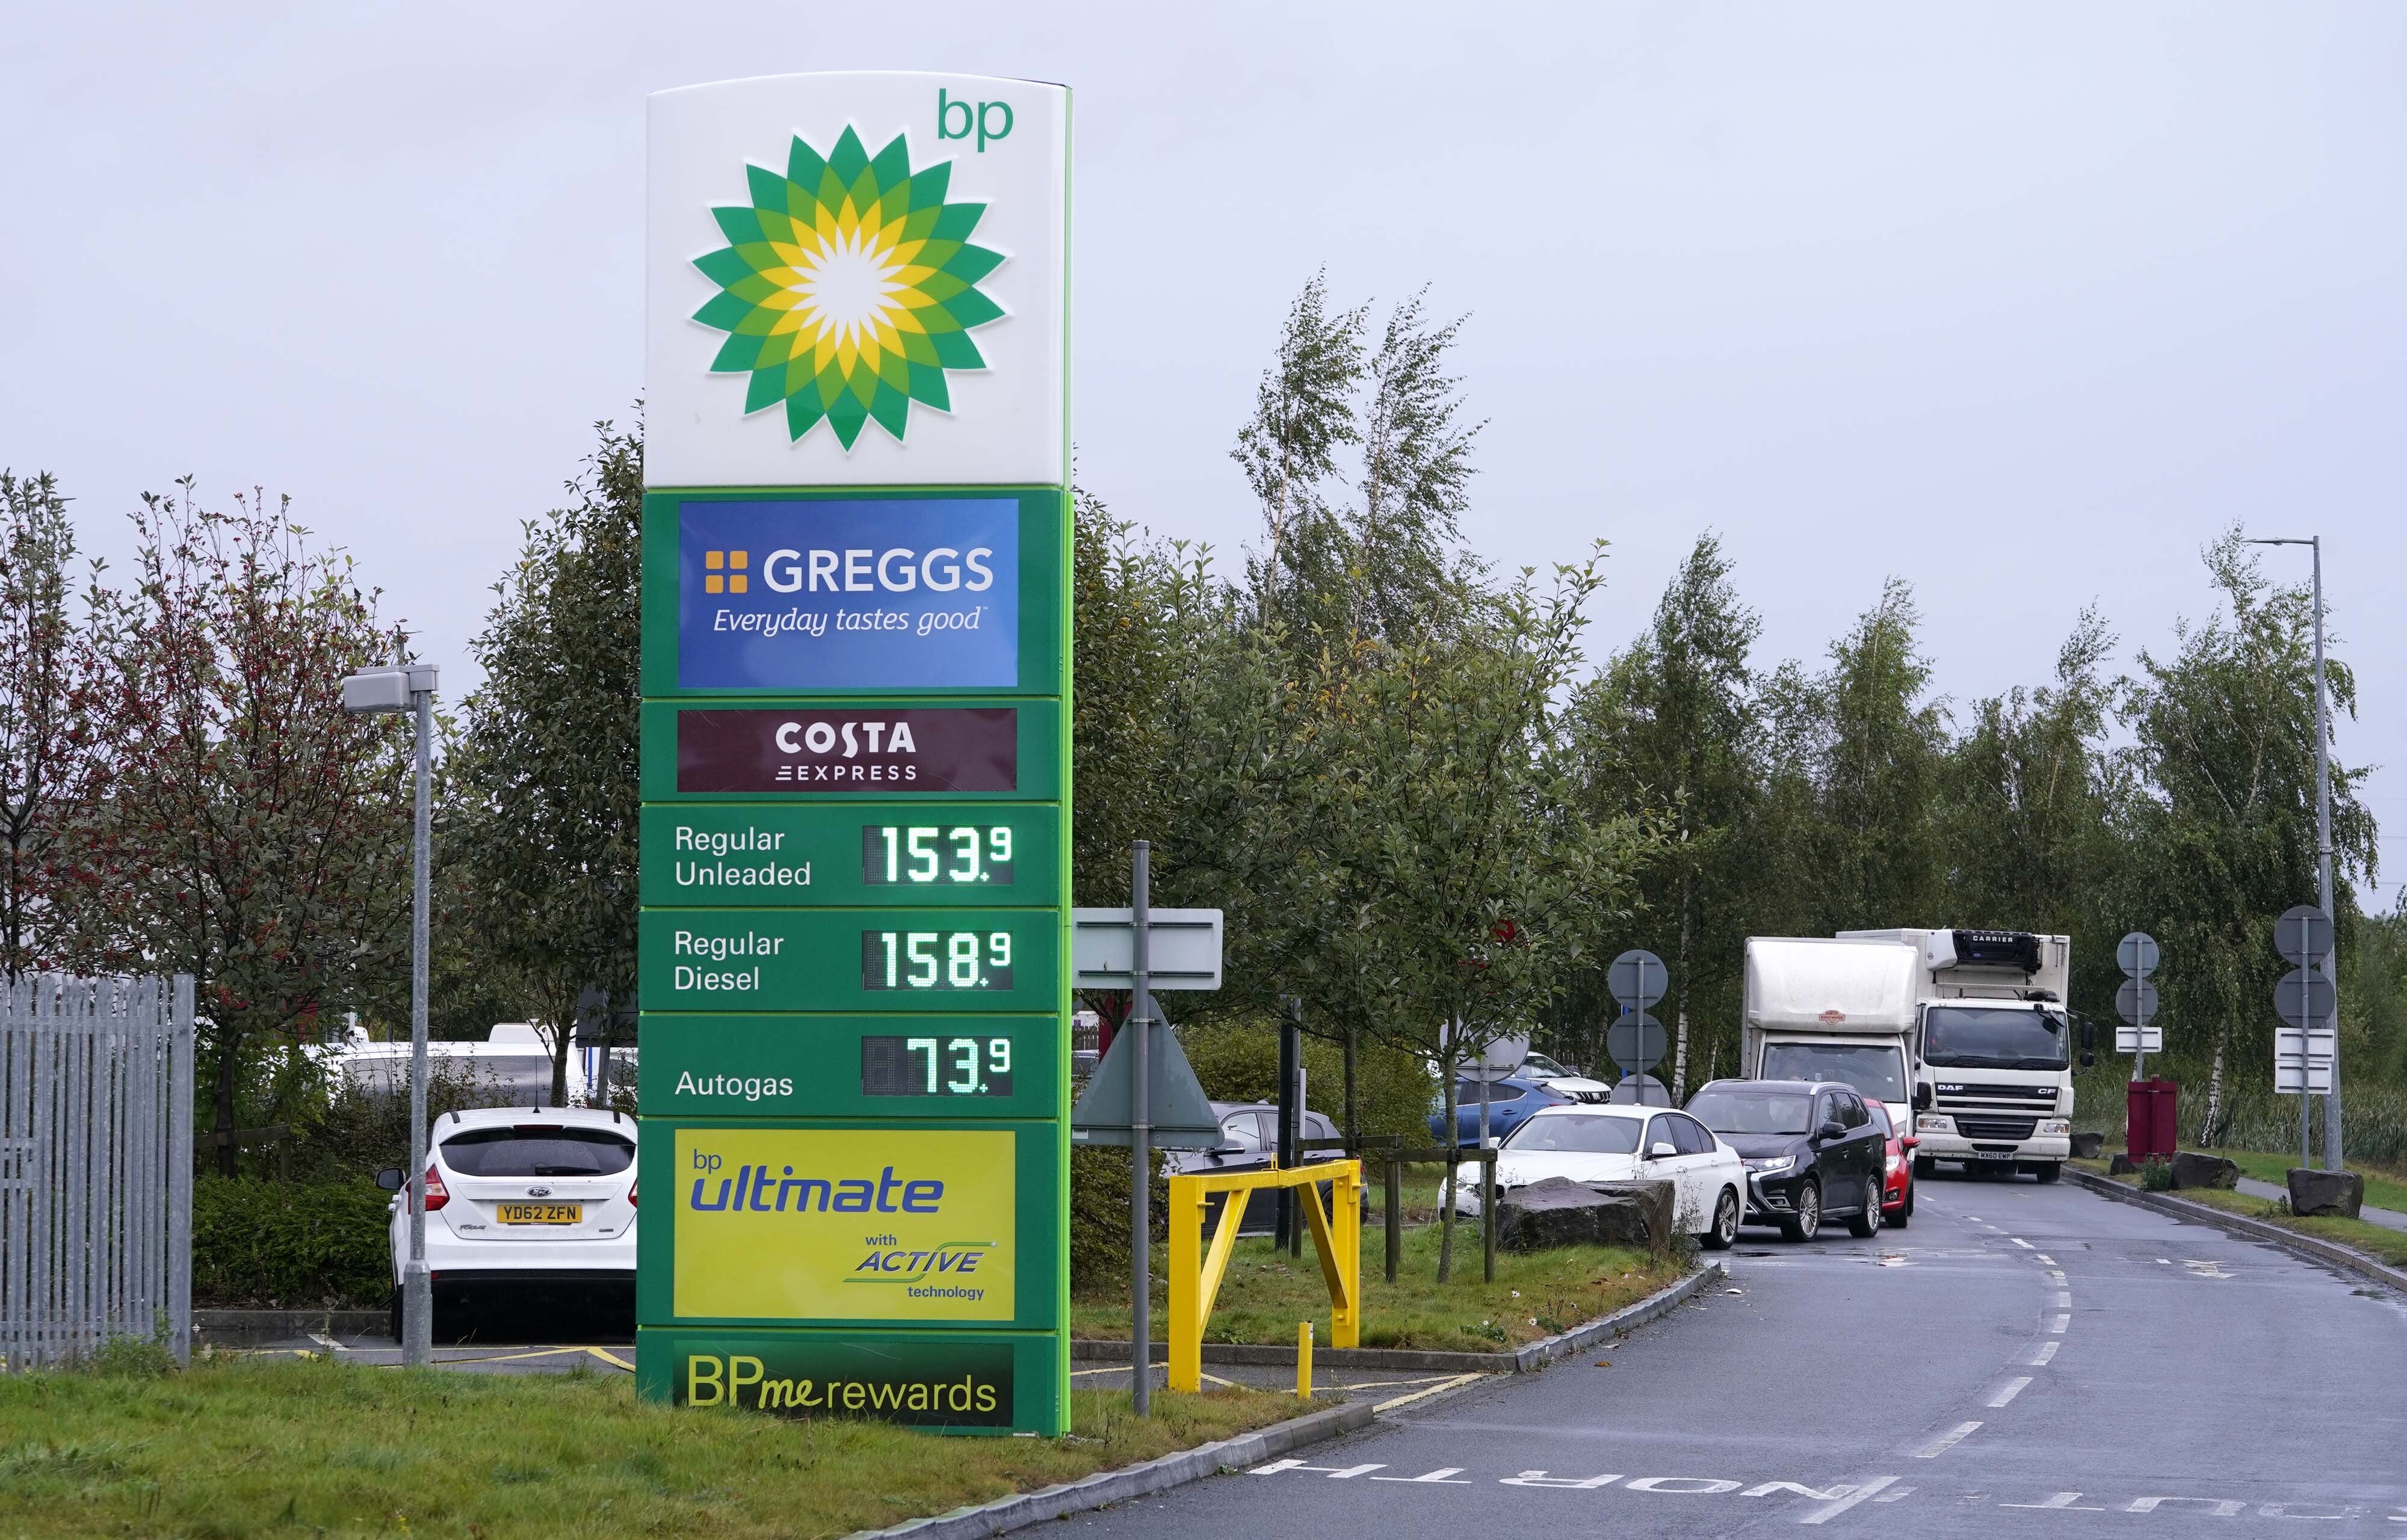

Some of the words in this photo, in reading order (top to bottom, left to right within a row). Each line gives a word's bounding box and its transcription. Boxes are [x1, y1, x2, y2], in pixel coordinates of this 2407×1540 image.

[937, 88, 1014, 153] bp
[763, 547, 994, 593] GREGGS
[713, 608, 828, 636] Everyday
[836, 609, 909, 630] tastes
[775, 722, 916, 759] COSTA
[797, 765, 916, 781] EXPRESS
[675, 827, 785, 855] Regular
[675, 861, 811, 886] Unleaded
[674, 931, 784, 961] Regular
[674, 967, 759, 991] Diesel
[675, 1071, 794, 1101] Autogas
[693, 1149, 722, 1174] bp
[690, 1165, 944, 1213] ultimate
[504, 1206, 543, 1220] YD62
[547, 1206, 576, 1220] ZFN
[865, 1234, 897, 1246] with
[855, 1251, 985, 1273] ACTIVE
[907, 1286, 984, 1301] technology
[827, 1374, 996, 1412] rewards
